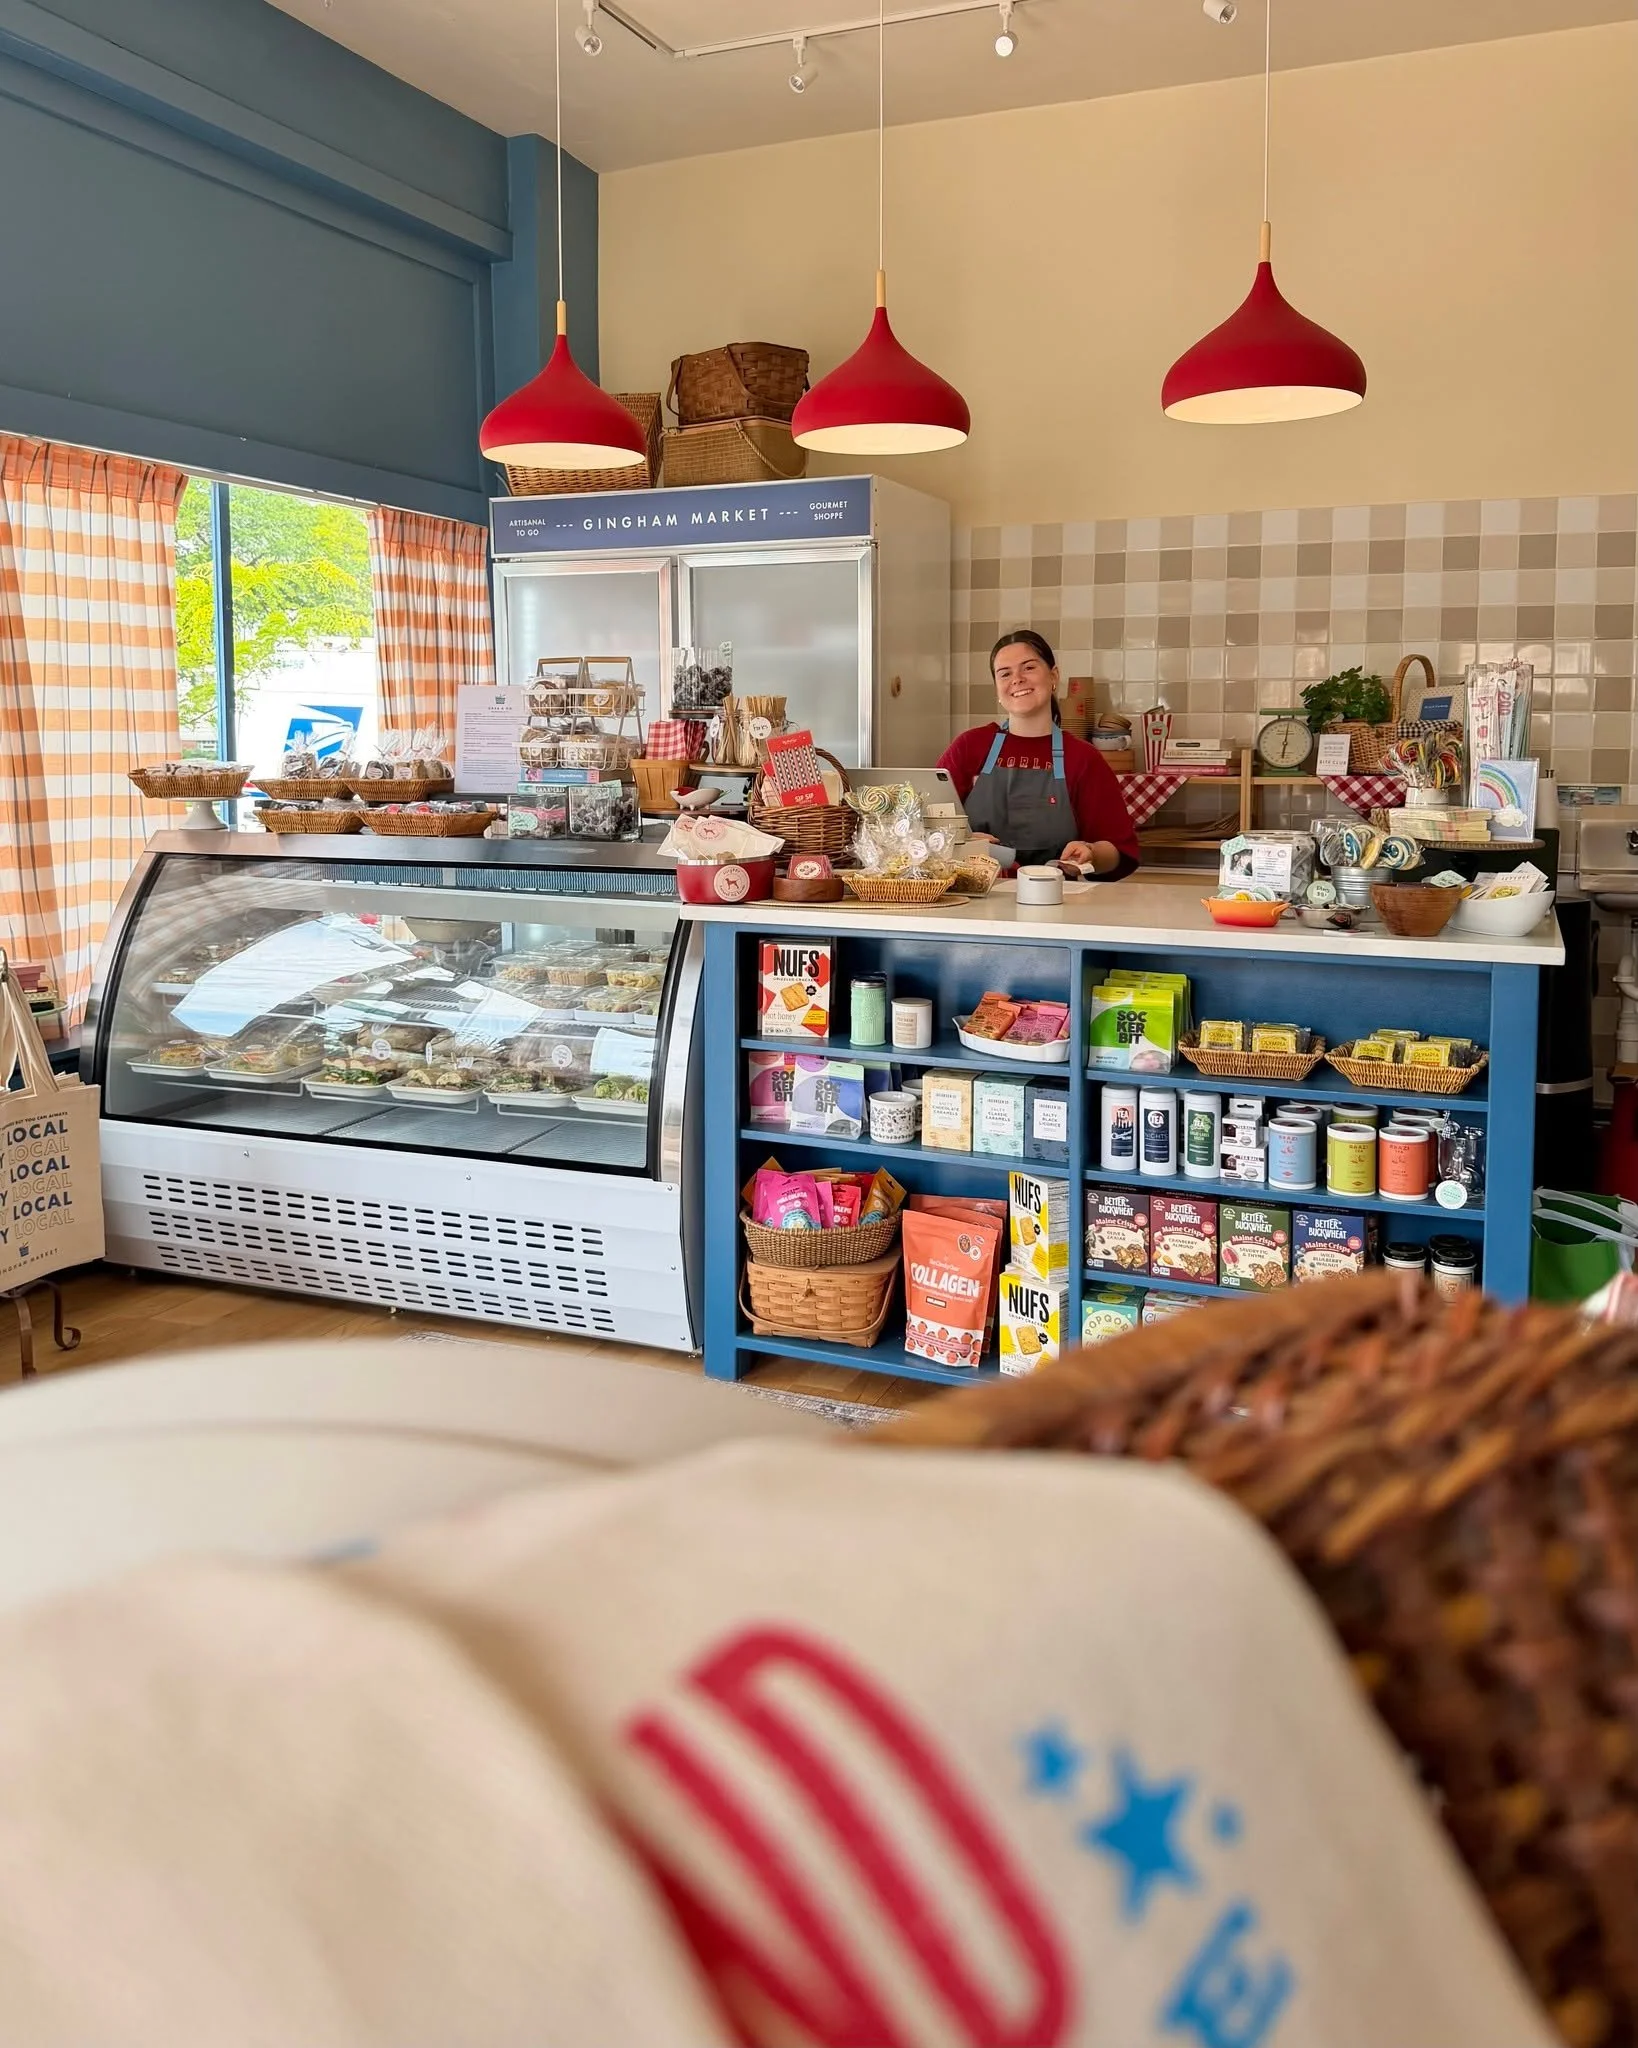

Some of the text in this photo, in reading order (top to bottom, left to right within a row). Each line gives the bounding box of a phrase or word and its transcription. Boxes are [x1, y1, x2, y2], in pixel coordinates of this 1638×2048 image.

[809, 501, 848, 510] GOURMET
[583, 508, 768, 531] GINGHAM MARKET
[814, 512, 843, 520] SHOPPE
[509, 519, 546, 527] ARTISANAL
[773, 949, 820, 977] NUFS
[1117, 1010, 1147, 1022] SOC
[1117, 1022, 1145, 1033] KER
[1119, 1033, 1142, 1044] BIT
[773, 1081, 794, 1091] KE
[816, 1079, 841, 1091] SOC
[815, 1090, 839, 1103] KER
[816, 1101, 836, 1114] BIT
[1151, 1115, 1164, 1124] TEA
[7, 1119, 68, 1146] LOCAL
[9, 1137, 70, 1165] LOCAL
[10, 1155, 70, 1183] LOCAL
[12, 1172, 73, 1202] LOCAL
[1014, 1174, 1041, 1214] NUFS
[14, 1191, 72, 1220] LOCAL
[1104, 1196, 1127, 1207] BETTER
[1099, 1205, 1134, 1216] BUCKWHEAT
[1171, 1204, 1194, 1214] BETTER
[1165, 1212, 1200, 1224] BUCKWHEAT
[1241, 1212, 1266, 1222] BETTER
[15, 1208, 74, 1239] LOCAL
[1117, 1219, 1137, 1229] Crisps
[1235, 1220, 1272, 1233] BUCKWHEAT
[1315, 1218, 1340, 1229] BETTER
[1183, 1226, 1204, 1238] Crisps
[1308, 1227, 1347, 1239] BUCKWHEAT
[1232, 1234, 1276, 1247] Maine Crisps
[1305, 1241, 1351, 1254] Maine Crisps
[911, 1262, 980, 1298] COLLAGEN
[1009, 1282, 1050, 1323] NUFS
[1085, 1314, 1129, 1336] POPQOR
